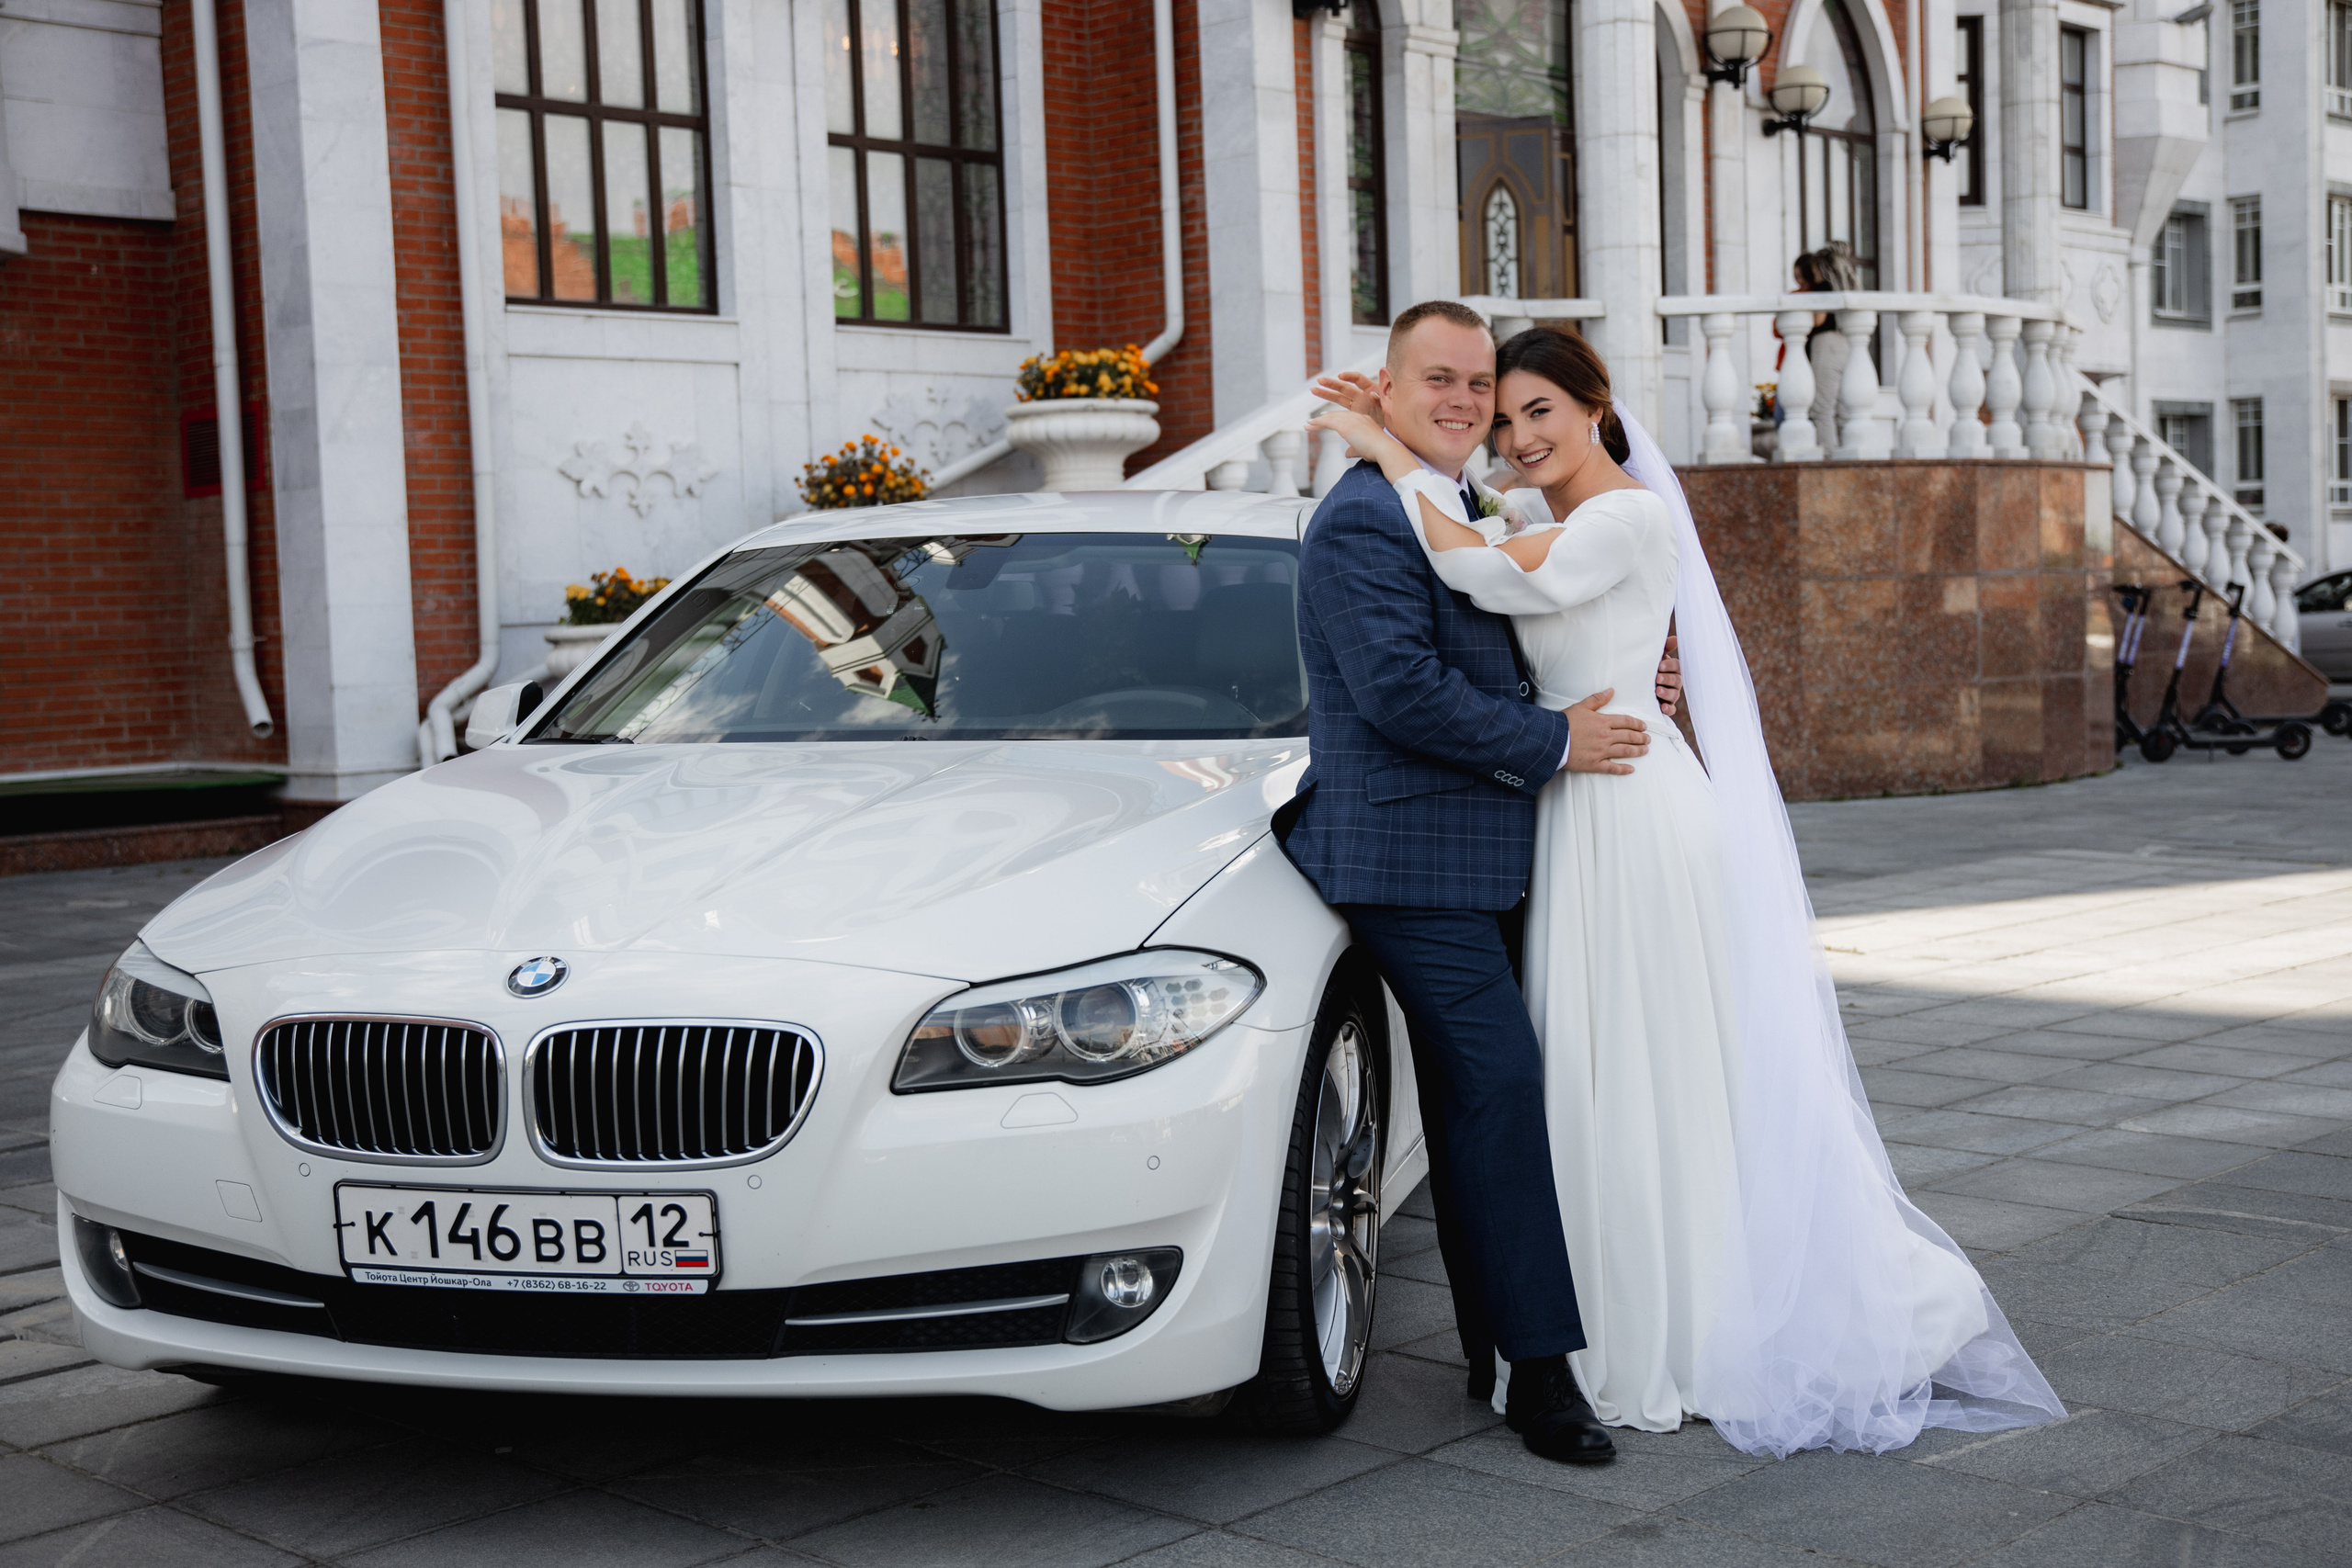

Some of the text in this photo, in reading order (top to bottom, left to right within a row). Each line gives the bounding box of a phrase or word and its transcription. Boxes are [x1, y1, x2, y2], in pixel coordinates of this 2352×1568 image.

[630, 1202, 690, 1247] 12
[628, 1250, 673, 1267] RUS
[365, 1271, 606, 1291] Тойота Центр Йошкар-Ола +7 (8362) 68-16-22
[645, 1282, 694, 1292] TOYOTA
